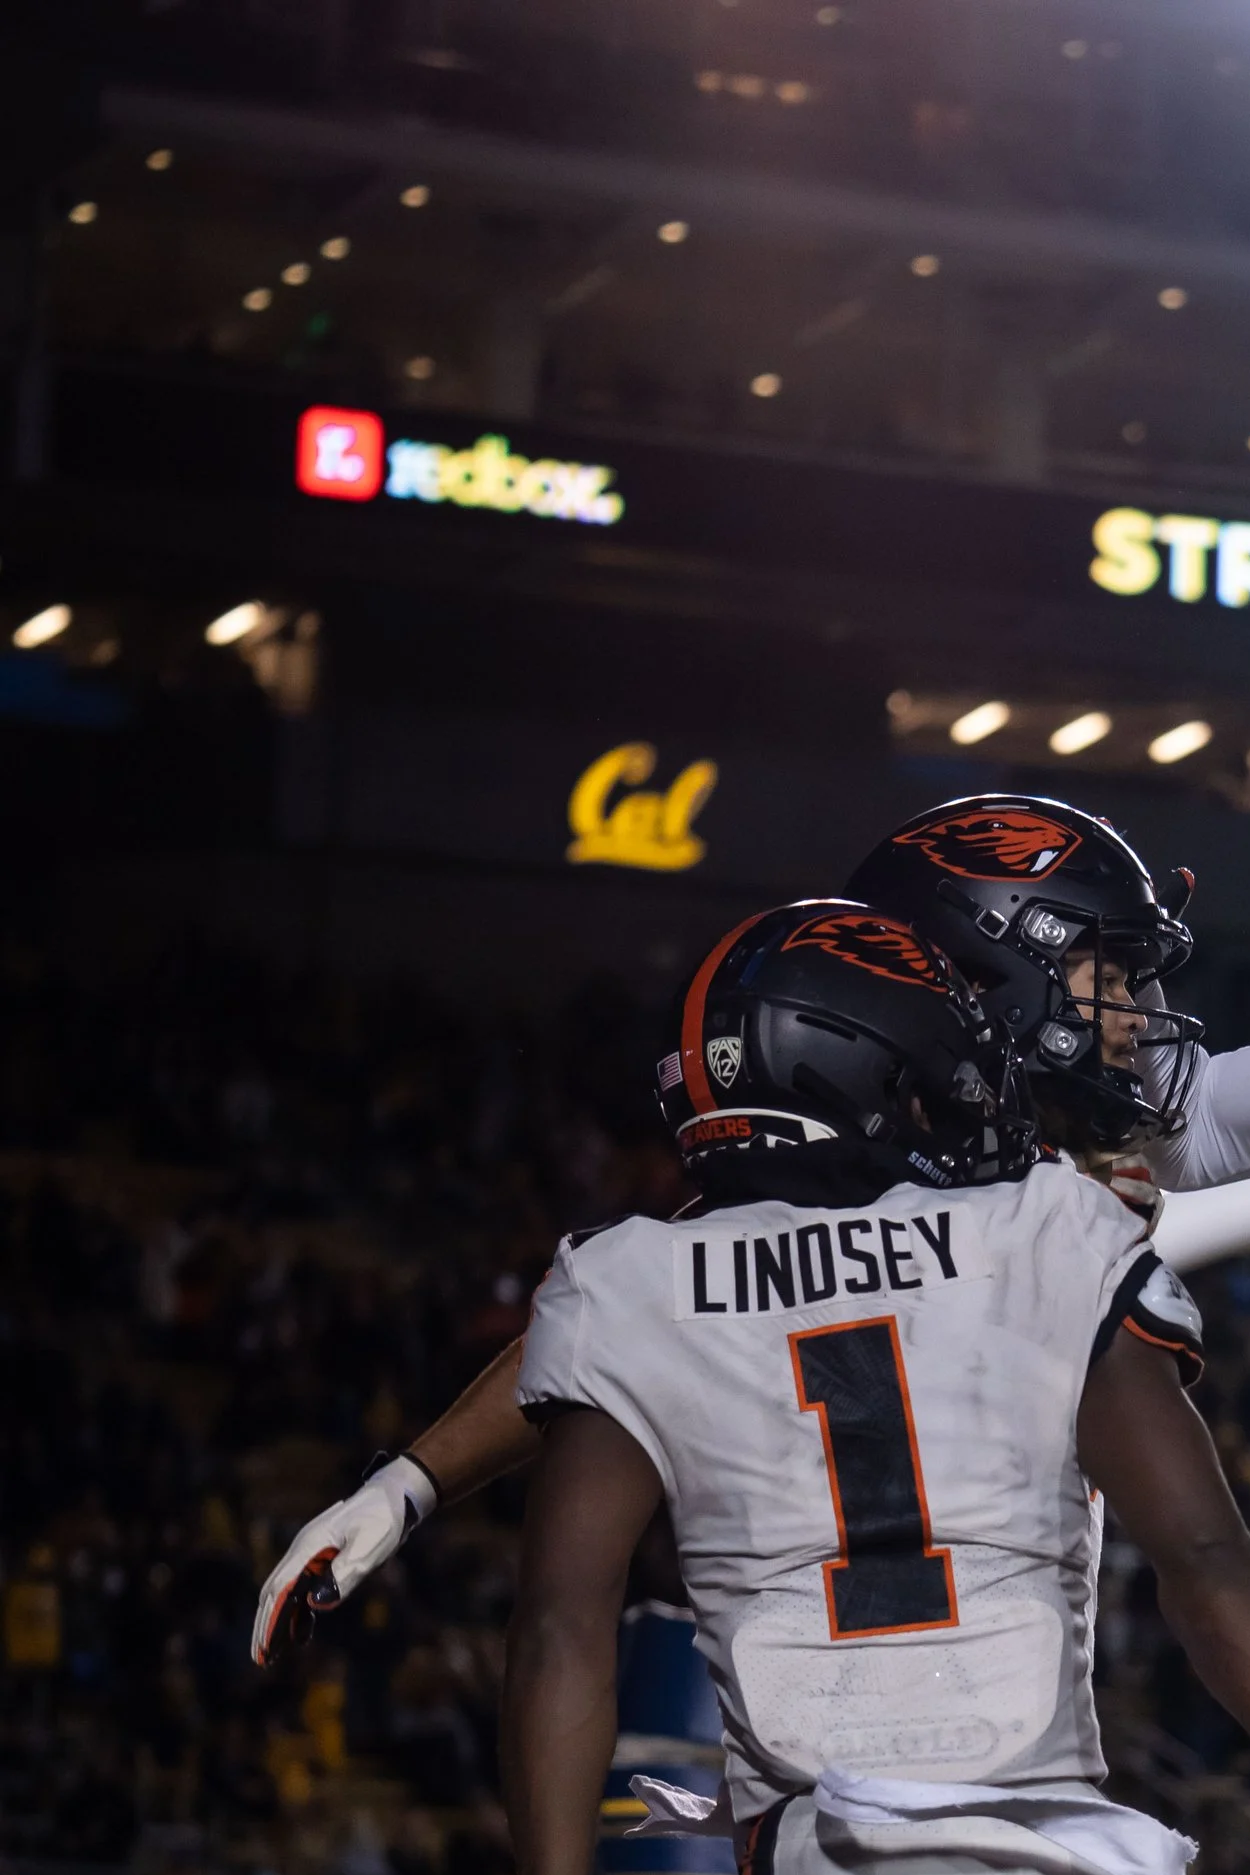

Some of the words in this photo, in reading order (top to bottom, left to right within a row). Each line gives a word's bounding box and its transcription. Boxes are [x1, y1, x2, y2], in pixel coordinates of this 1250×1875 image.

[563, 740, 719, 872] Cal
[707, 1037, 742, 1068] PAC
[716, 1058, 734, 1078] 12
[693, 1211, 959, 1314] LINDSEY
[787, 1316, 959, 1639] 1
